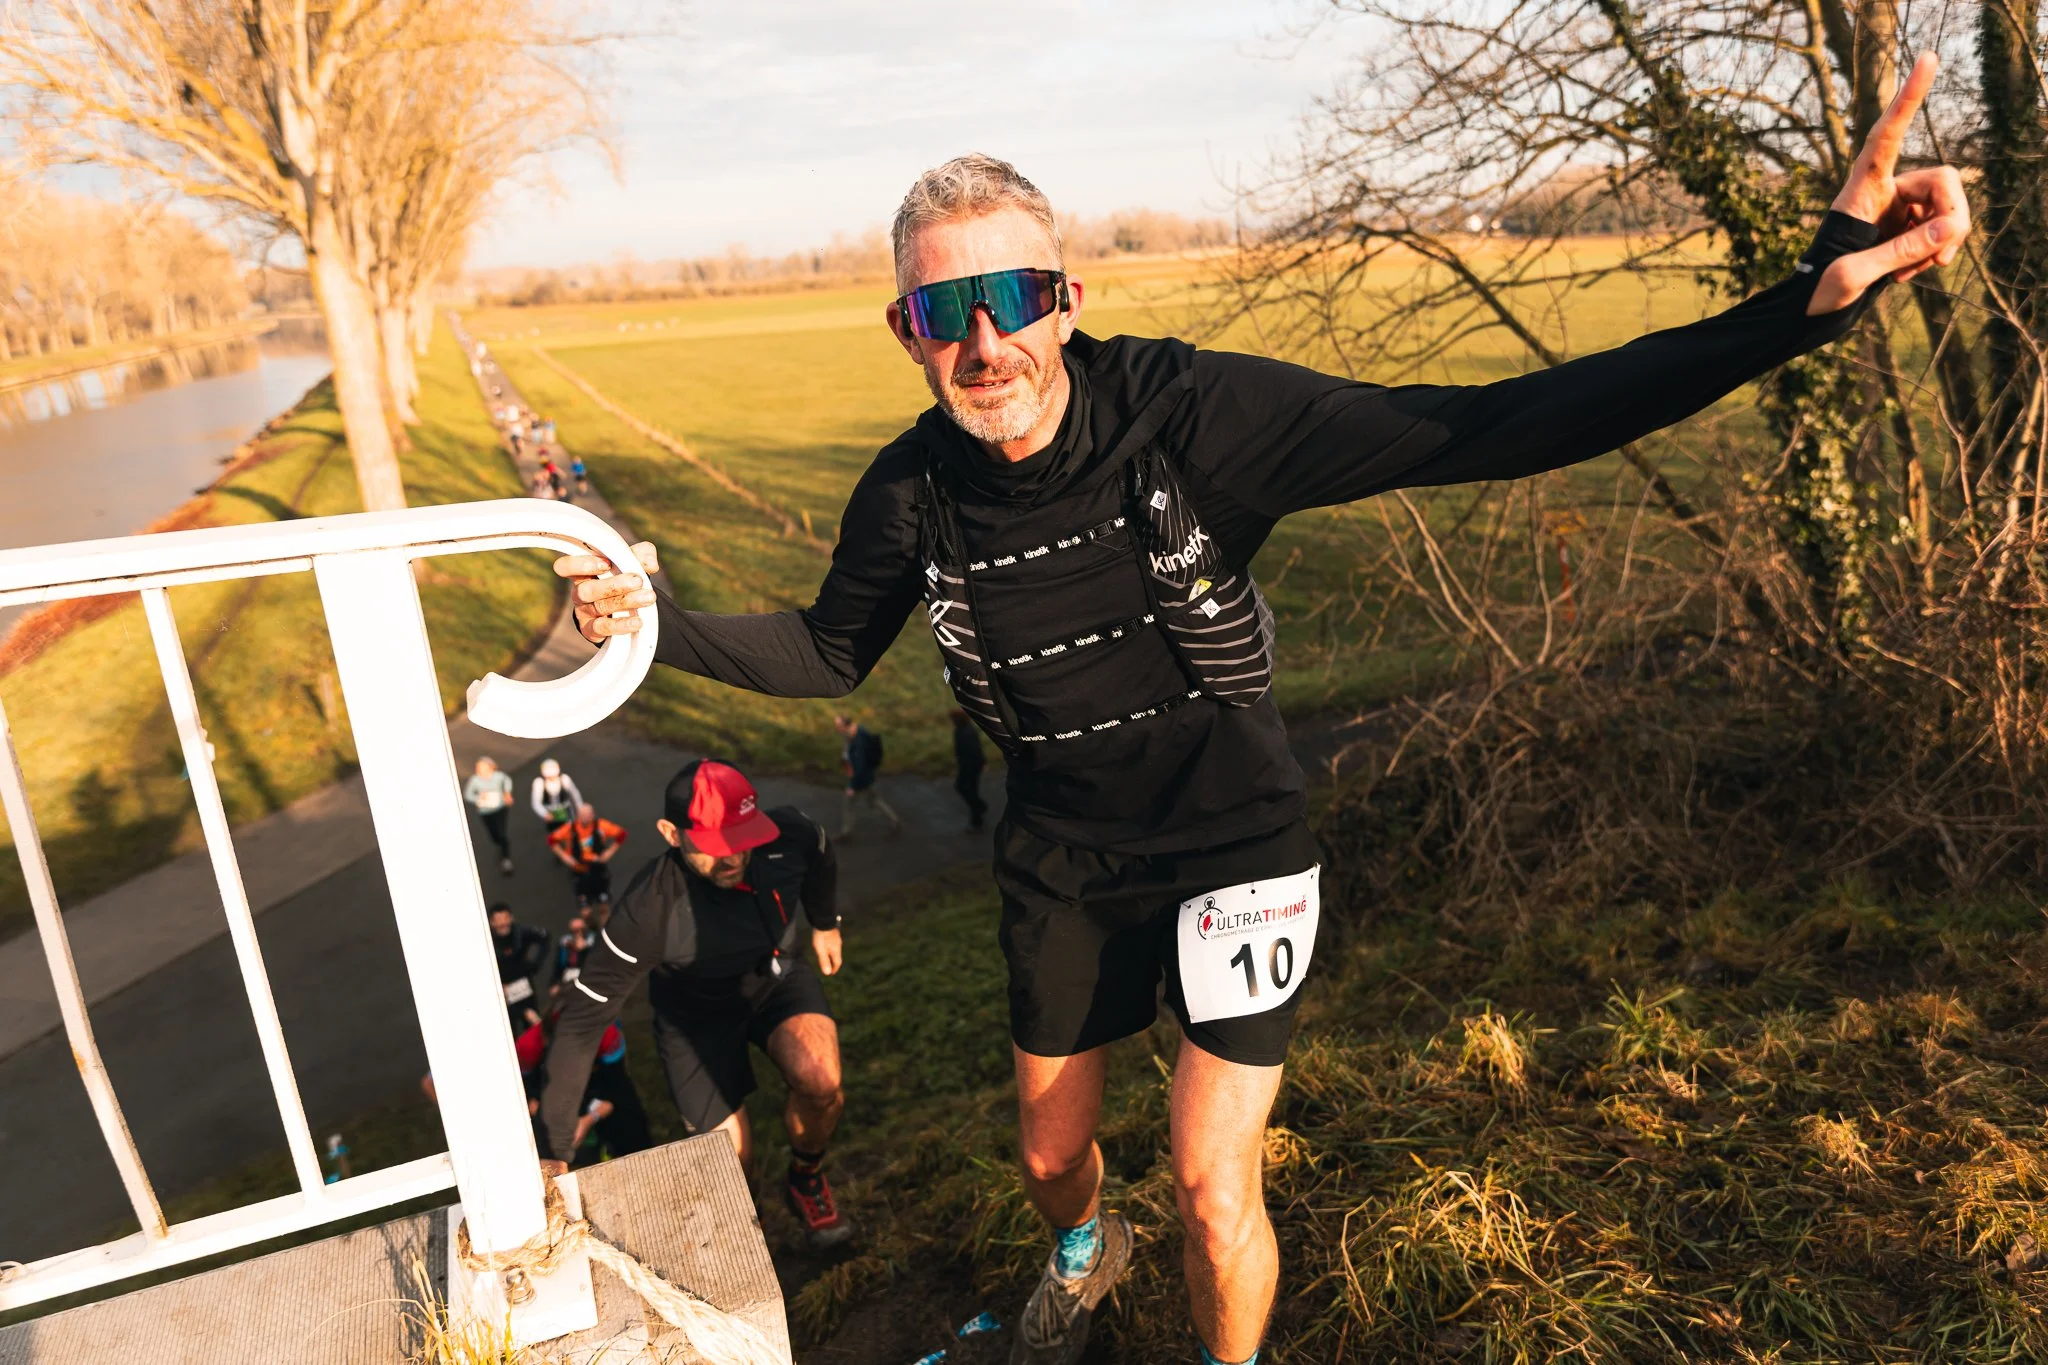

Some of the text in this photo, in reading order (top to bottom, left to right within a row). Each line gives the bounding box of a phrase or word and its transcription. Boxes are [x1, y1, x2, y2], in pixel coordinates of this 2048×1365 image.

[994, 555, 1017, 567] kinetik
[1024, 545, 1050, 560] kinetik
[1008, 654, 1033, 666] kinetik
[1040, 644, 1067, 657] kinetik
[1054, 730, 1083, 740] kinetik
[1091, 719, 1121, 732] kinetik
[1217, 899, 1306, 931] ULTRATIMING
[1230, 937, 1294, 998] 10
